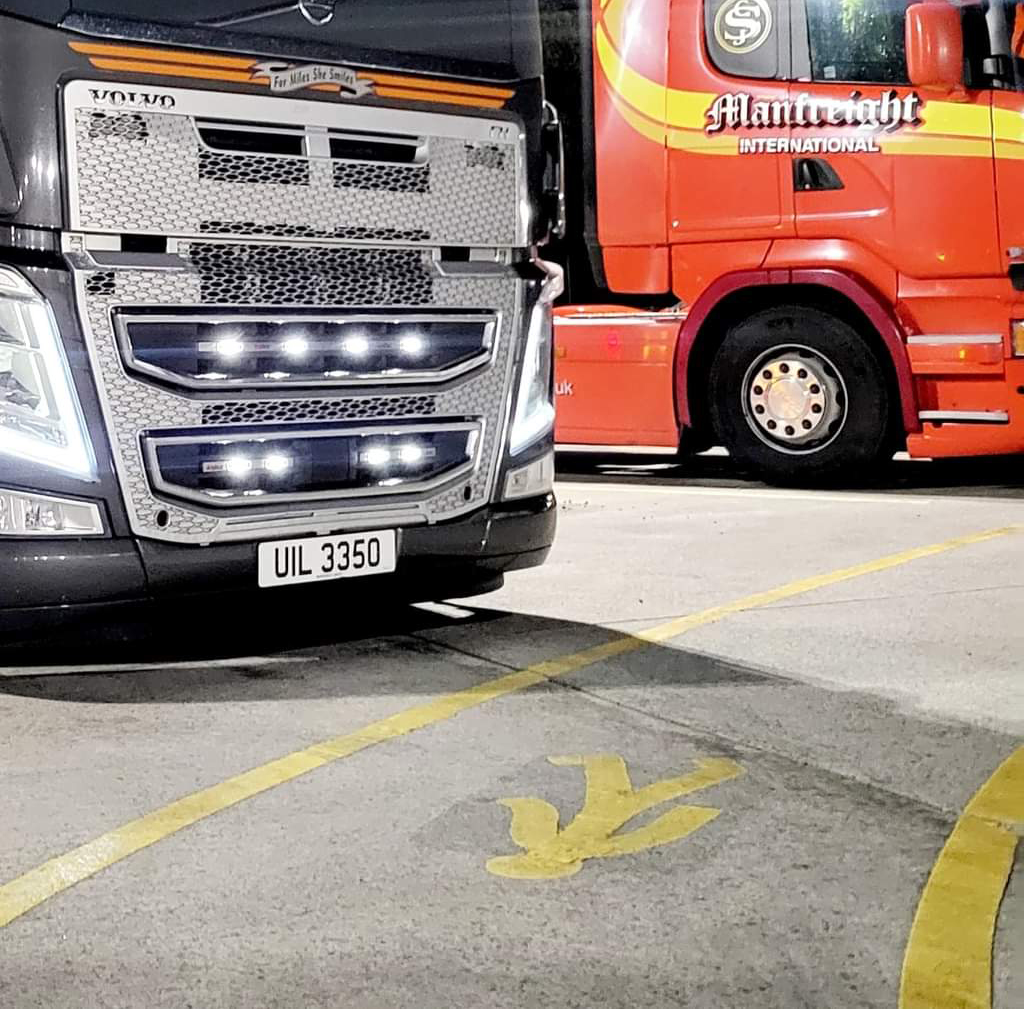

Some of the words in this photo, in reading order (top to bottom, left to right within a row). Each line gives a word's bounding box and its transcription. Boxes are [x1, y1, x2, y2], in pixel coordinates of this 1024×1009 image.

[274, 75, 287, 88] For
[313, 67, 326, 80] She
[329, 69, 353, 85] Smiles
[88, 88, 176, 109] VOLVO
[706, 89, 921, 133] Manfreight
[739, 137, 881, 155] INTERNATIONAL
[275, 545, 313, 578] UIL
[321, 537, 380, 573] 3350
